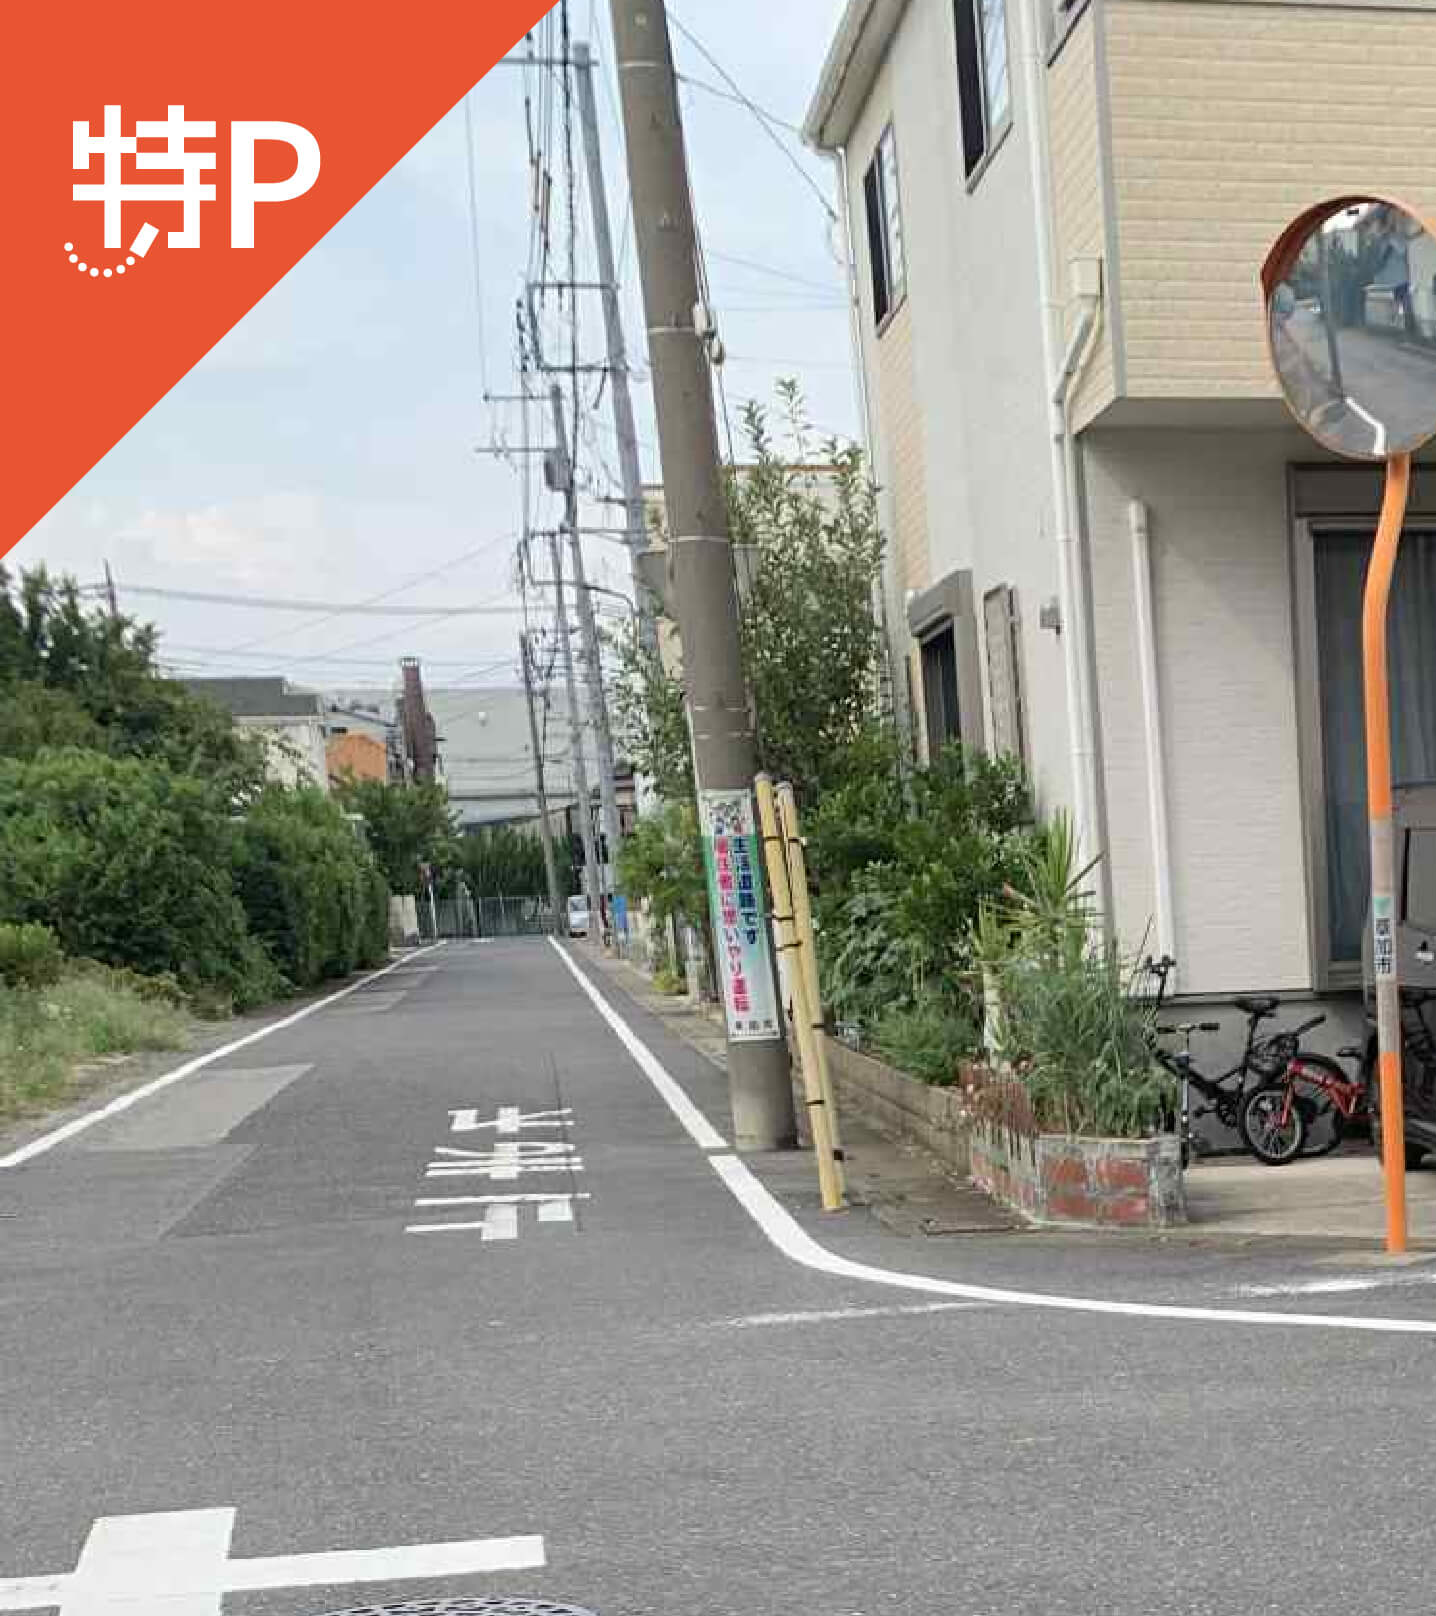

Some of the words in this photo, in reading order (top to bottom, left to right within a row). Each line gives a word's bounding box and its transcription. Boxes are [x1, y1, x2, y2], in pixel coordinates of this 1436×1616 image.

[732, 835, 756, 944] 生活道路です
[1375, 917, 1392, 974] 草加市
[405, 1105, 592, 1241] 止まれ
